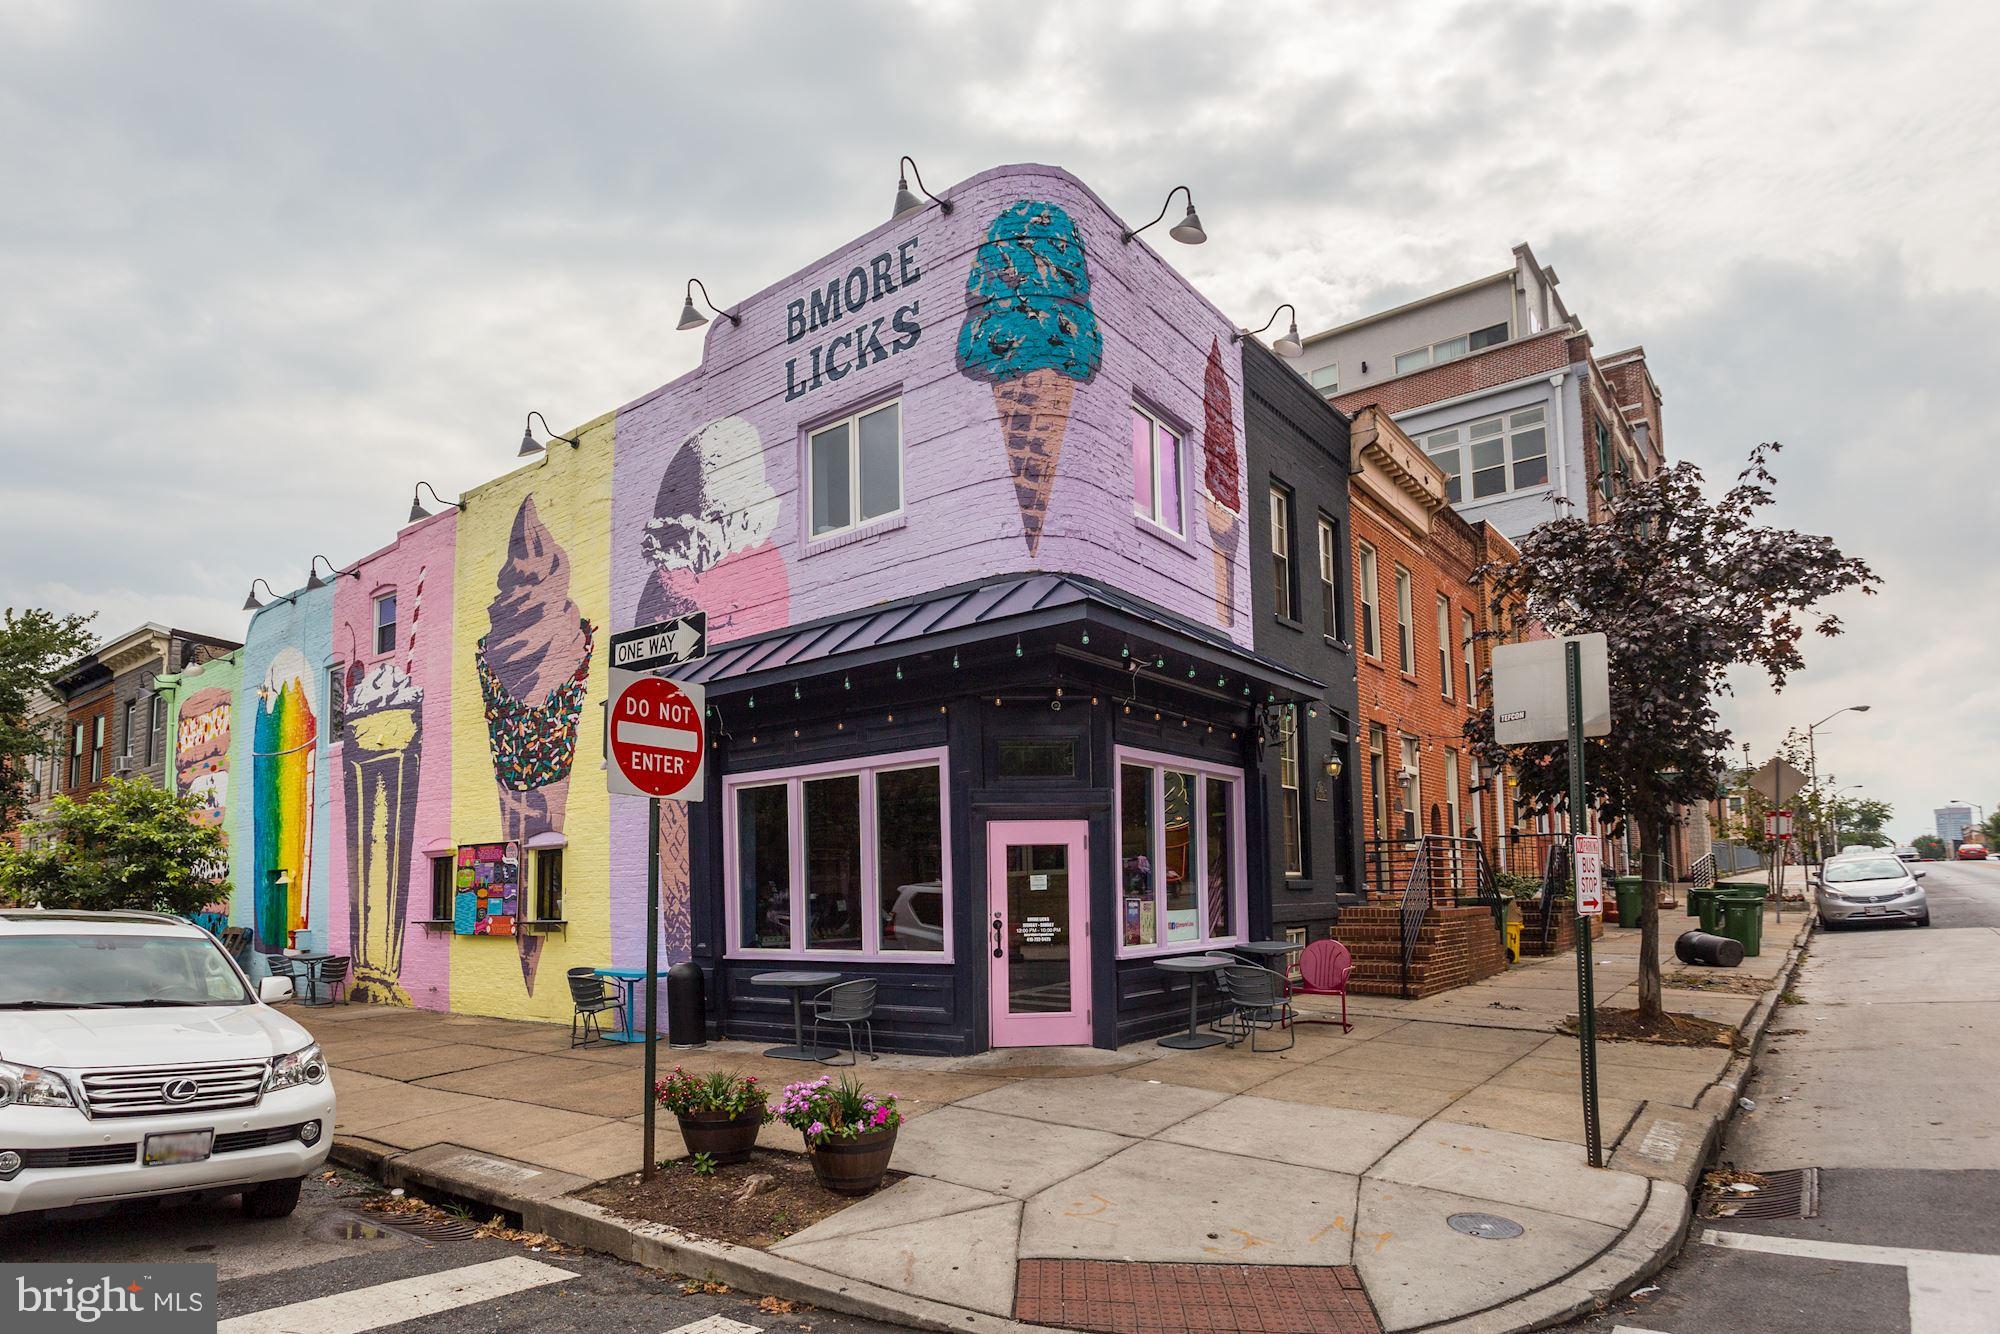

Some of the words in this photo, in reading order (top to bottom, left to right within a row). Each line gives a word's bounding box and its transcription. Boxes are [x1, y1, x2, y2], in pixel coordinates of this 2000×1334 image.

[786, 237, 921, 344] BMORE
[785, 300, 922, 402] LICKS
[618, 641, 644, 662] ONE
[649, 633, 676, 656] WAY
[626, 697, 650, 717] DO
[659, 702, 691, 724] NOT
[1501, 711, 1525, 722] TEFCON
[631, 751, 684, 774] ENTER
[1582, 857, 1595, 873] BUS
[1581, 877, 1598, 893] STOP
